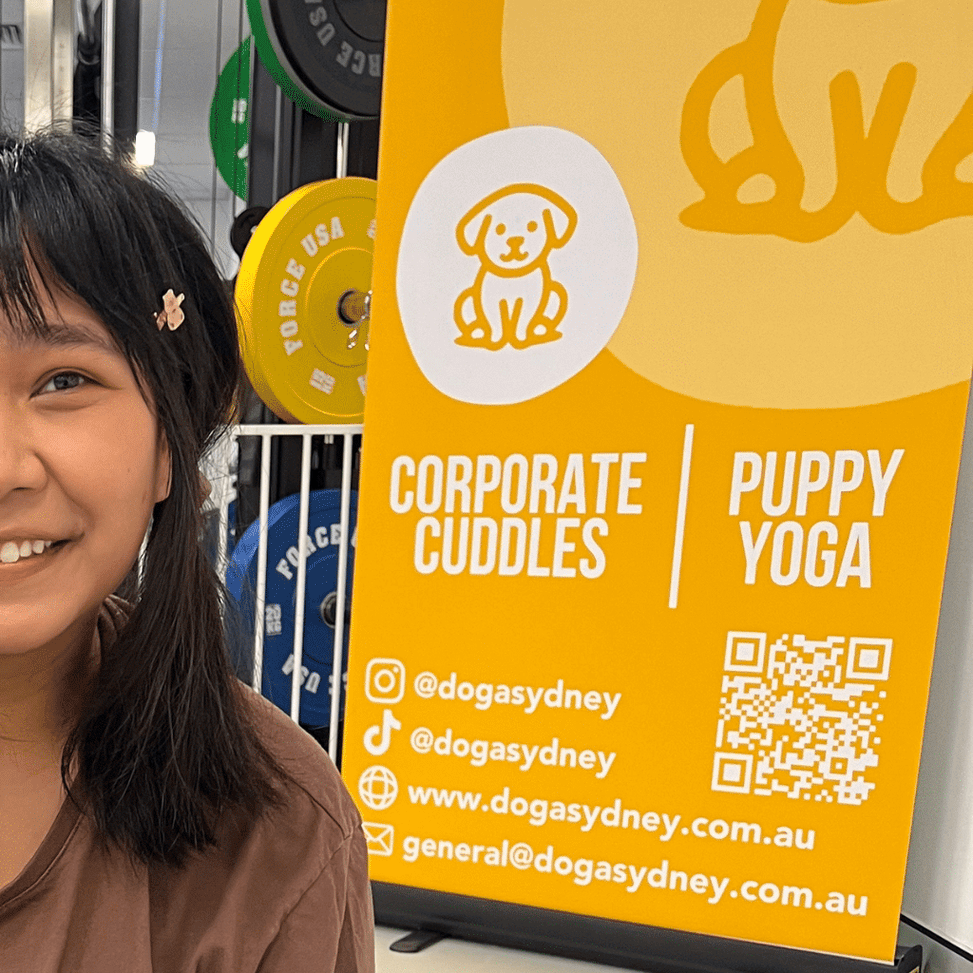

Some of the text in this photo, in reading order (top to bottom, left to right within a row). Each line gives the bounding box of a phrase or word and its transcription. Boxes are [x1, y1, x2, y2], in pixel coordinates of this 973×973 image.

[304, 0, 381, 77] RCE US
[278, 216, 345, 356] FORCE USA
[389, 452, 647, 516] CORPORATE
[728, 450, 905, 517] PUPPY
[414, 516, 609, 579] CUDDLES
[739, 520, 871, 588] YOGA
[412, 670, 622, 720] @dogasydney
[408, 726, 617, 779] @dogasydney
[407, 785, 816, 850] www.dogasydney.com.au
[402, 836, 868, 916] general@dogasydney.com.au
